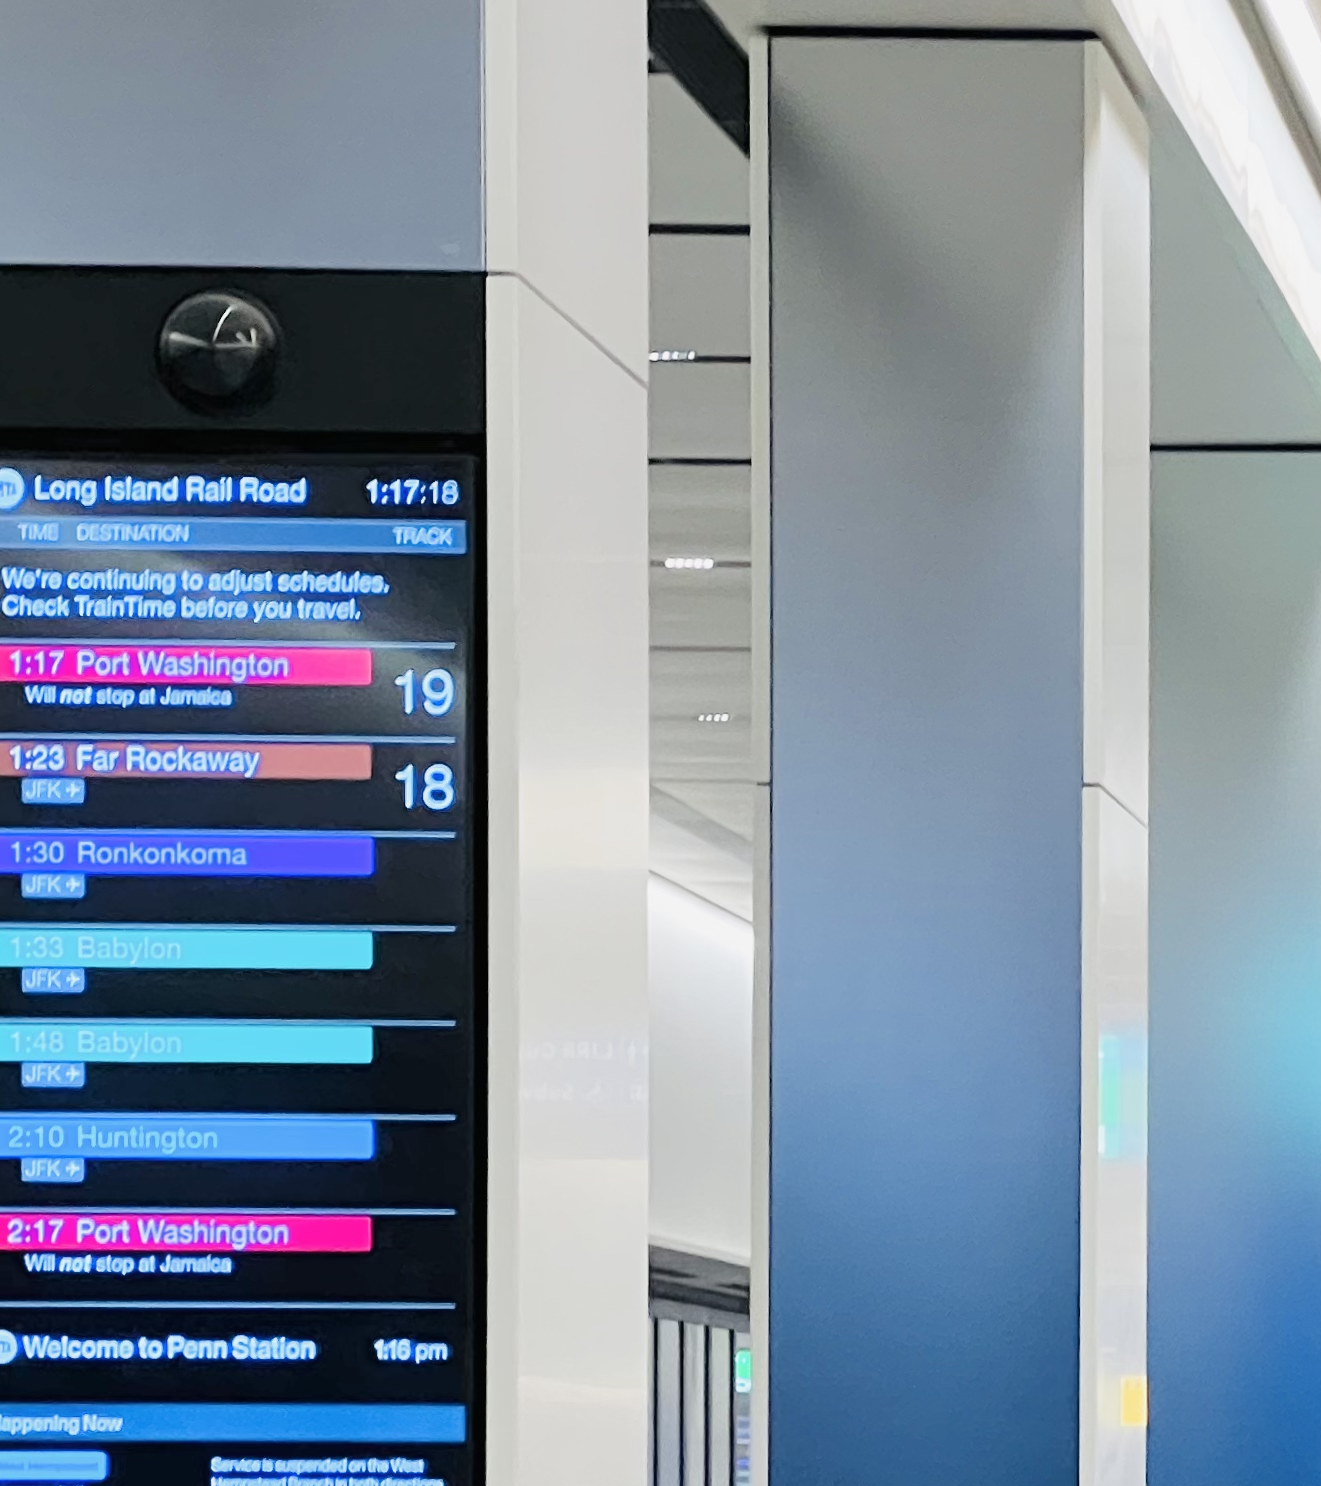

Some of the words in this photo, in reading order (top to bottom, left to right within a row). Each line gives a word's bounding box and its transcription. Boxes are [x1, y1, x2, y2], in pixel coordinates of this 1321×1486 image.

[34, 476, 97, 506] Long
[104, 476, 180, 502] Island
[185, 476, 233, 502] Rail
[239, 477, 307, 503] Road
[366, 479, 459, 506] 1:17:18
[18, 525, 59, 541] TIME
[76, 525, 190, 543] DESTINATION
[393, 528, 453, 545] TRACK
[2, 568, 62, 591] We're
[67, 569, 176, 595] continuing
[182, 571, 201, 592] to
[208, 571, 273, 595] adjust
[277, 571, 390, 595] schedules.
[2, 595, 69, 617] Check
[74, 596, 176, 618] TrainTime
[181, 598, 248, 619] before
[253, 603, 291, 623] you
[297, 599, 361, 621] travel.
[9, 651, 64, 675] 1:17
[76, 651, 129, 677] Port
[137, 652, 289, 683] Washington
[25, 687, 56, 705] Will
[60, 687, 93, 706] not
[96, 688, 134, 709] stop
[139, 689, 155, 706] at
[160, 687, 232, 707] Jamaica
[394, 668, 454, 717] 19
[9, 746, 65, 771] 1:23
[76, 746, 119, 771] Far
[126, 747, 259, 778] Rockaway
[25, 782, 62, 800] JFK
[394, 763, 455, 812] 18
[10, 842, 64, 864] 1:30
[78, 841, 247, 866] Ronkonkoma
[25, 876, 62, 893] JFK
[9, 936, 64, 959] 1:33
[77, 937, 182, 965] Babylon
[25, 971, 62, 989] JFK
[9, 1031, 64, 1053] 1:48
[78, 1032, 182, 1060] Babylon
[25, 1066, 62, 1083] JFK
[8, 1126, 64, 1148] 2:10
[77, 1126, 218, 1154] Huntington
[25, 1160, 62, 1177] JFK
[7, 1219, 64, 1243] 2:17
[76, 1218, 129, 1244] Port
[137, 1220, 290, 1250] Washington
[24, 1254, 56, 1272] Will
[59, 1254, 92, 1273] not
[96, 1255, 134, 1276] stop
[139, 1256, 155, 1273] at
[160, 1254, 232, 1274] Jamaica
[23, 1335, 133, 1360] Welcome
[138, 1338, 163, 1360] to
[167, 1336, 226, 1360] Penn
[232, 1335, 317, 1361] Station
[414, 1342, 449, 1364] pm
[83, 1414, 123, 1432] Now
[211, 1457, 261, 1472] Service
[262, 1458, 273, 1472] is
[275, 1458, 347, 1475] suspended
[349, 1460, 366, 1473] on
[367, 1459, 389, 1473] the
